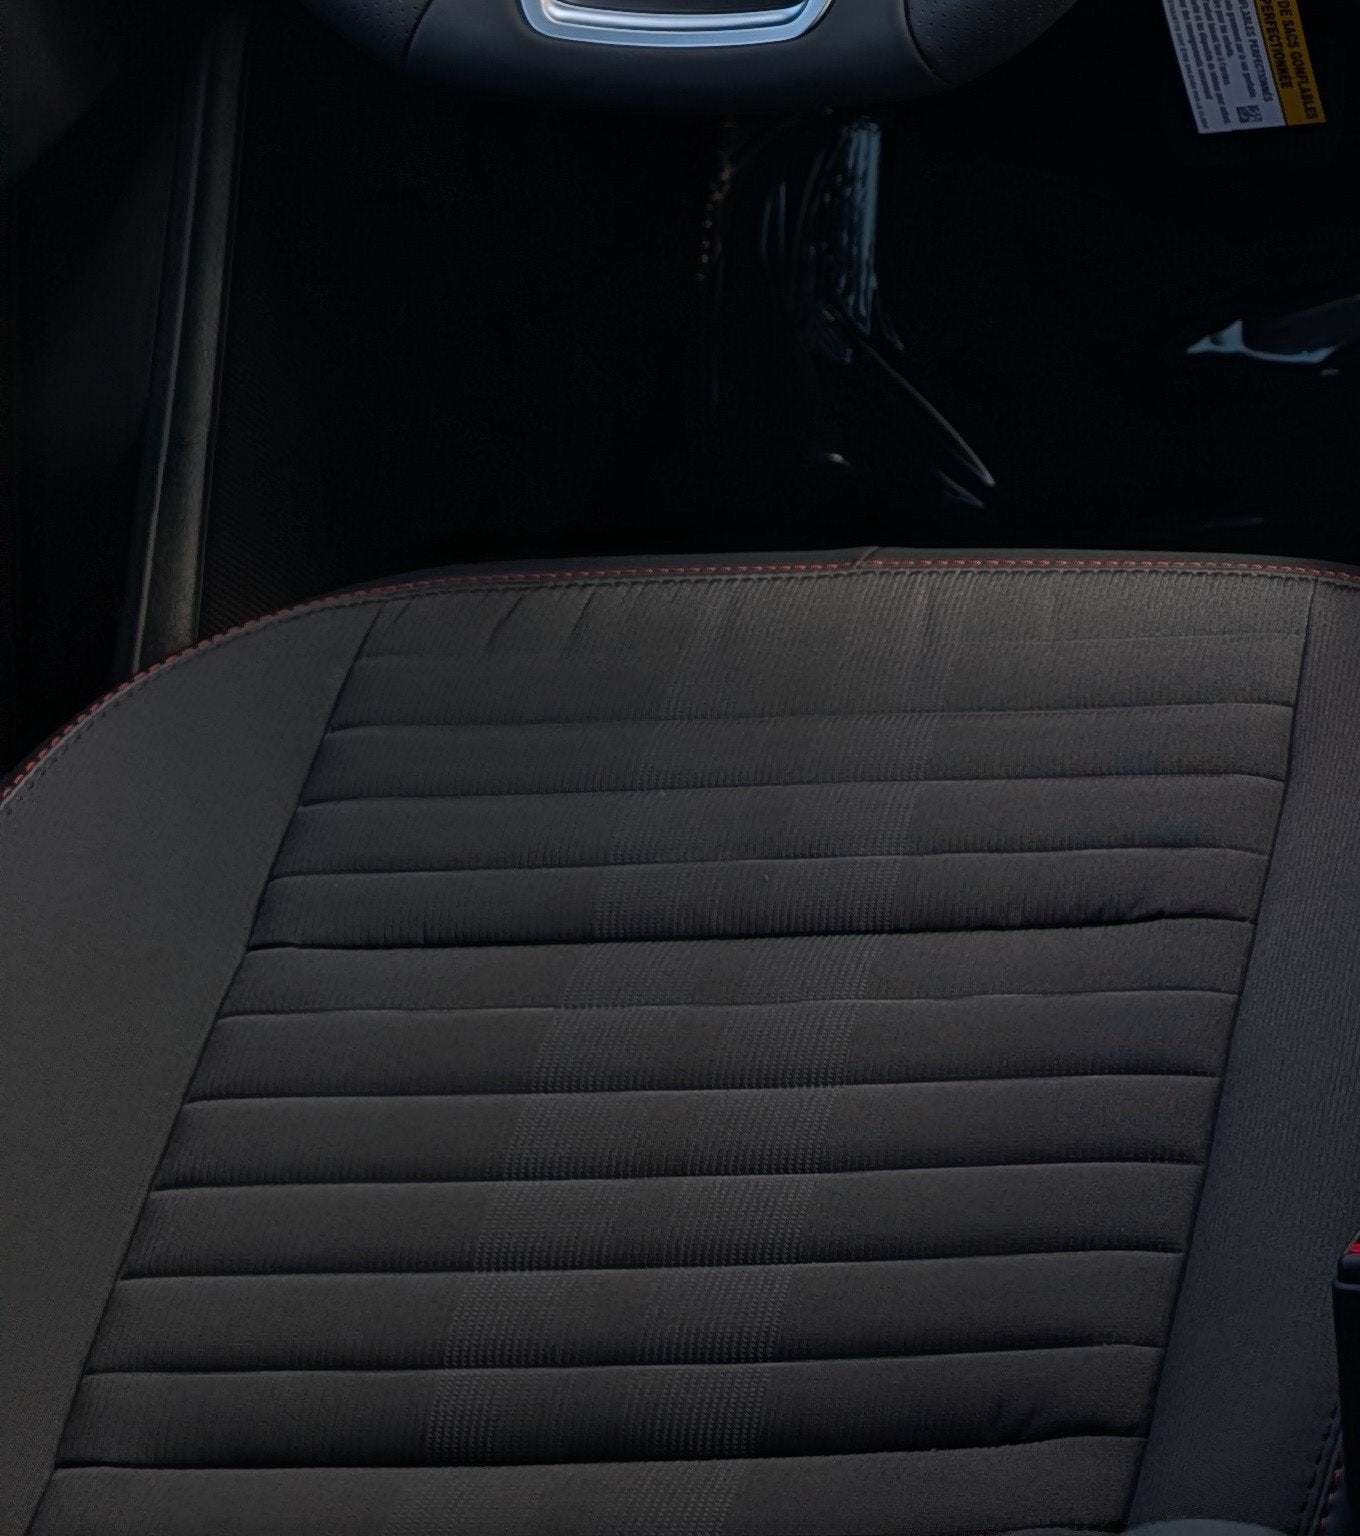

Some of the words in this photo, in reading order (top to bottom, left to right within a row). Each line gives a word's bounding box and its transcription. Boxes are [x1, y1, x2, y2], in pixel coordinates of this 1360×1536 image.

[1276, 0, 1292, 16] DE
[1281, 19, 1300, 48] SACS
[1289, 51, 1318, 119] GONFLABLES
